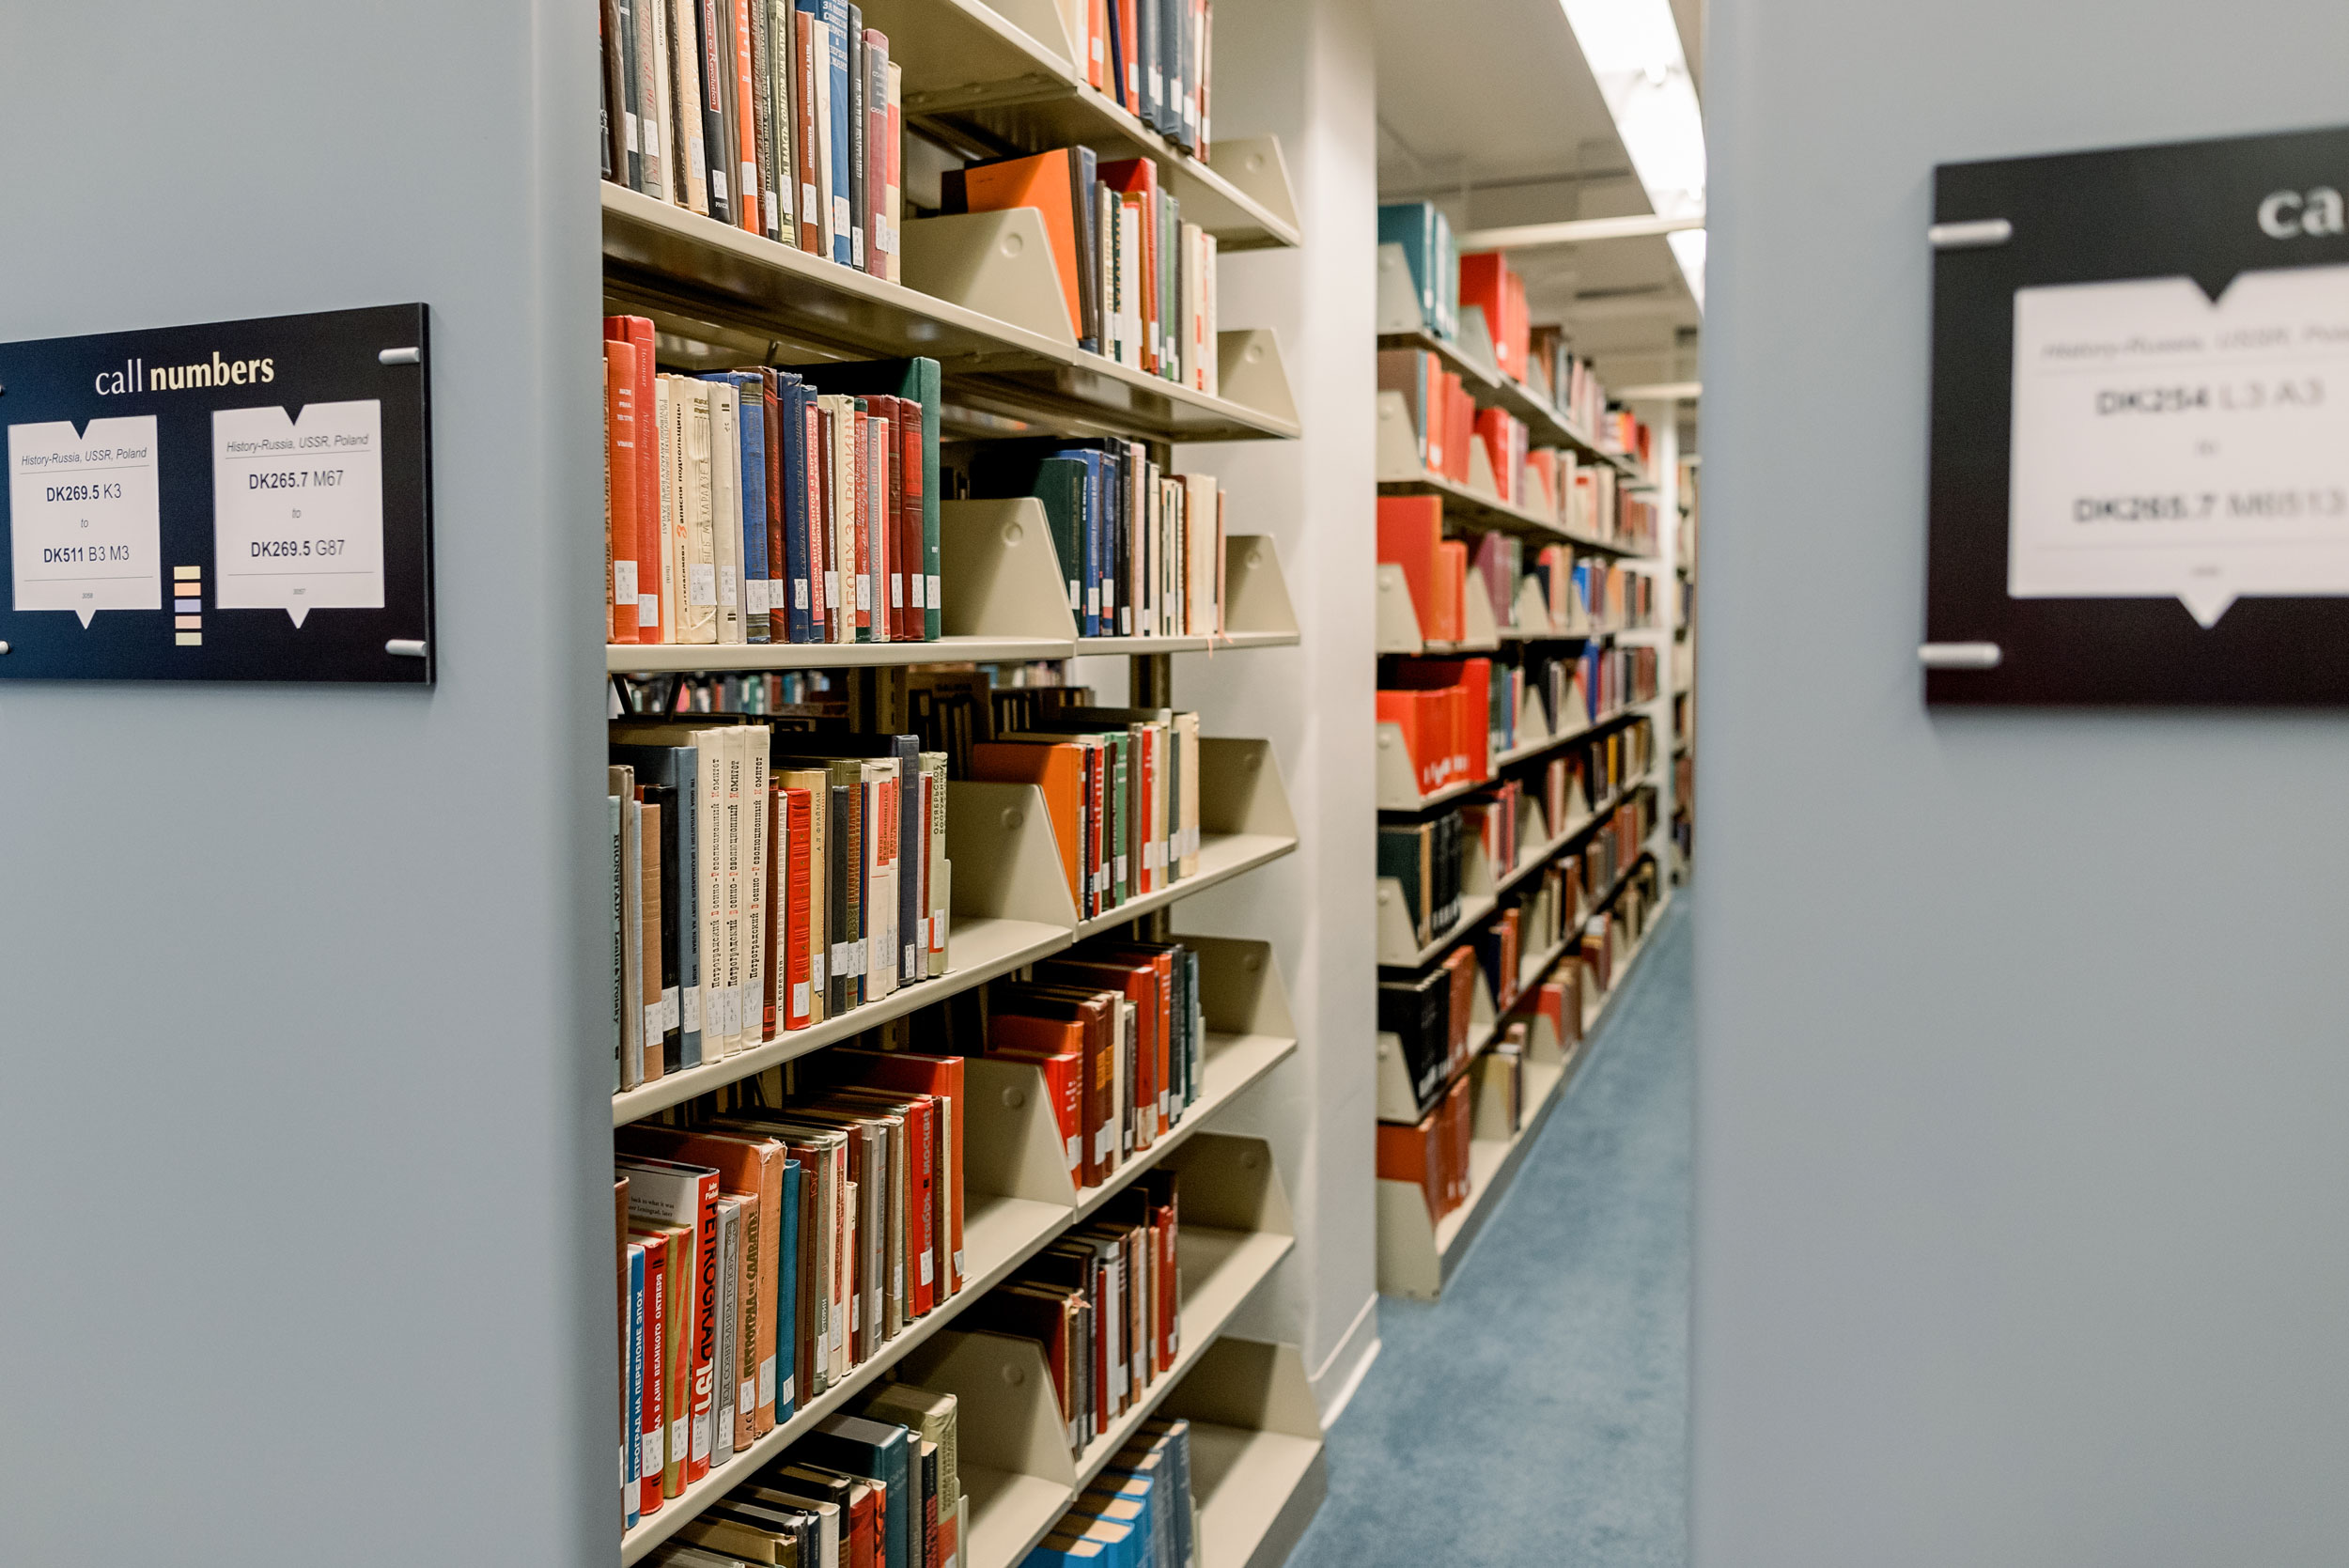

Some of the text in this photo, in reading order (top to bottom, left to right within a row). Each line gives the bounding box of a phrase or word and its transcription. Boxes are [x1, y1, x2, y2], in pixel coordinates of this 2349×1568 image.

[708, 53, 719, 106] Revolution
[764, 141, 772, 192] REVOLUTIO
[95, 350, 274, 396] call numbers
[21, 446, 148, 470] History-Russia, USSR, Poland
[226, 433, 369, 456] History-Russia, USSR, Poland
[806, 410, 815, 476] ВНУТРЕННЕЙ
[46, 483, 122, 503] DK269.5 K3
[249, 469, 344, 489] DK265.7 M67
[81, 518, 89, 529] to
[292, 508, 302, 519] to
[810, 490, 818, 564] ИНТЕРВЕНТОВ
[845, 510, 855, 536] ЗА
[43, 545, 130, 564] DK511 B3 M3
[250, 539, 345, 558] DK269.5 G87
[846, 542, 855, 606] БОЯХ
[847, 613, 855, 628] В
[613, 833, 621, 922] KRONSTADT
[709, 919, 722, 989] Петроградский
[726, 919, 739, 987] Петроградский
[750, 912, 760, 980] Петроградский
[694, 1203, 719, 1414] PETROGRAD 191
[723, 1302, 732, 1380] СОЗВЕЗДИЕМ
[743, 1296, 756, 1378] ПЕТРОГРАД
[633, 1289, 644, 1479] ЕТРОГРАД НА ПЕРЕЛОМЕ ЭПОХ
[723, 1381, 731, 1407] ПОД
